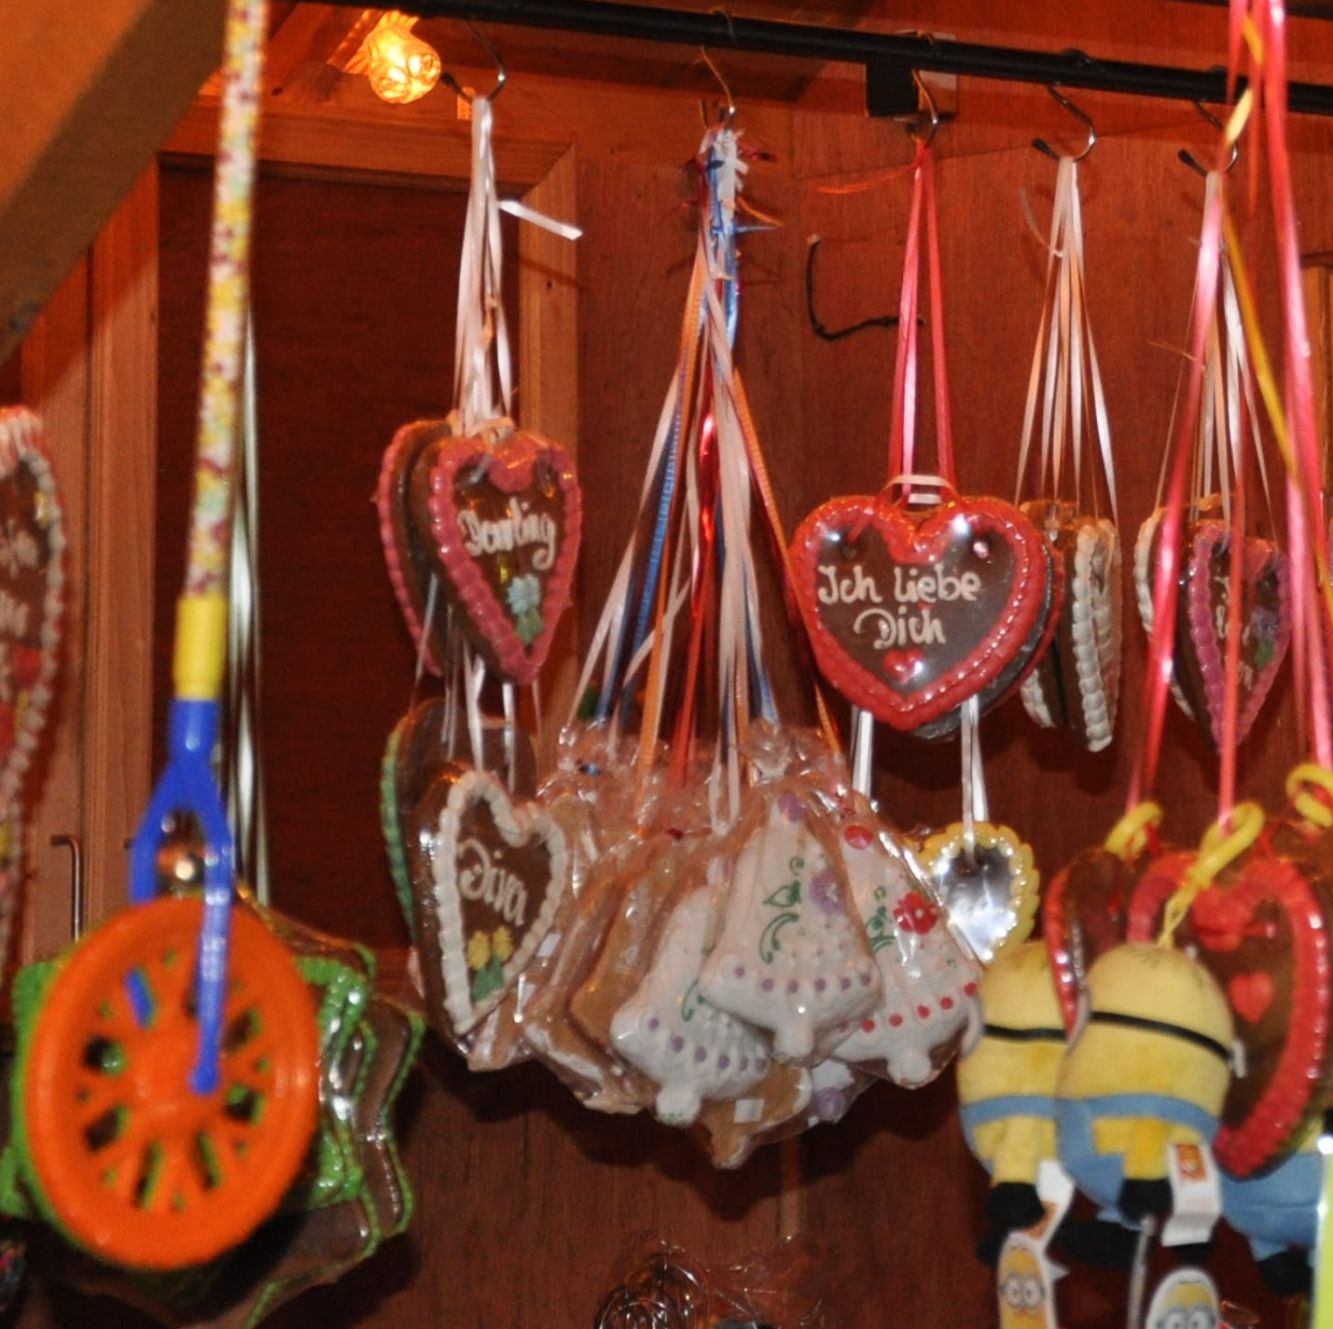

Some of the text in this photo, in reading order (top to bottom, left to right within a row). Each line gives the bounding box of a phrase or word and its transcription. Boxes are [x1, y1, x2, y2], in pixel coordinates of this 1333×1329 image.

[818, 561, 981, 604] Ich liebe
[853, 604, 946, 650] Dich
[459, 838, 528, 926] Diva
